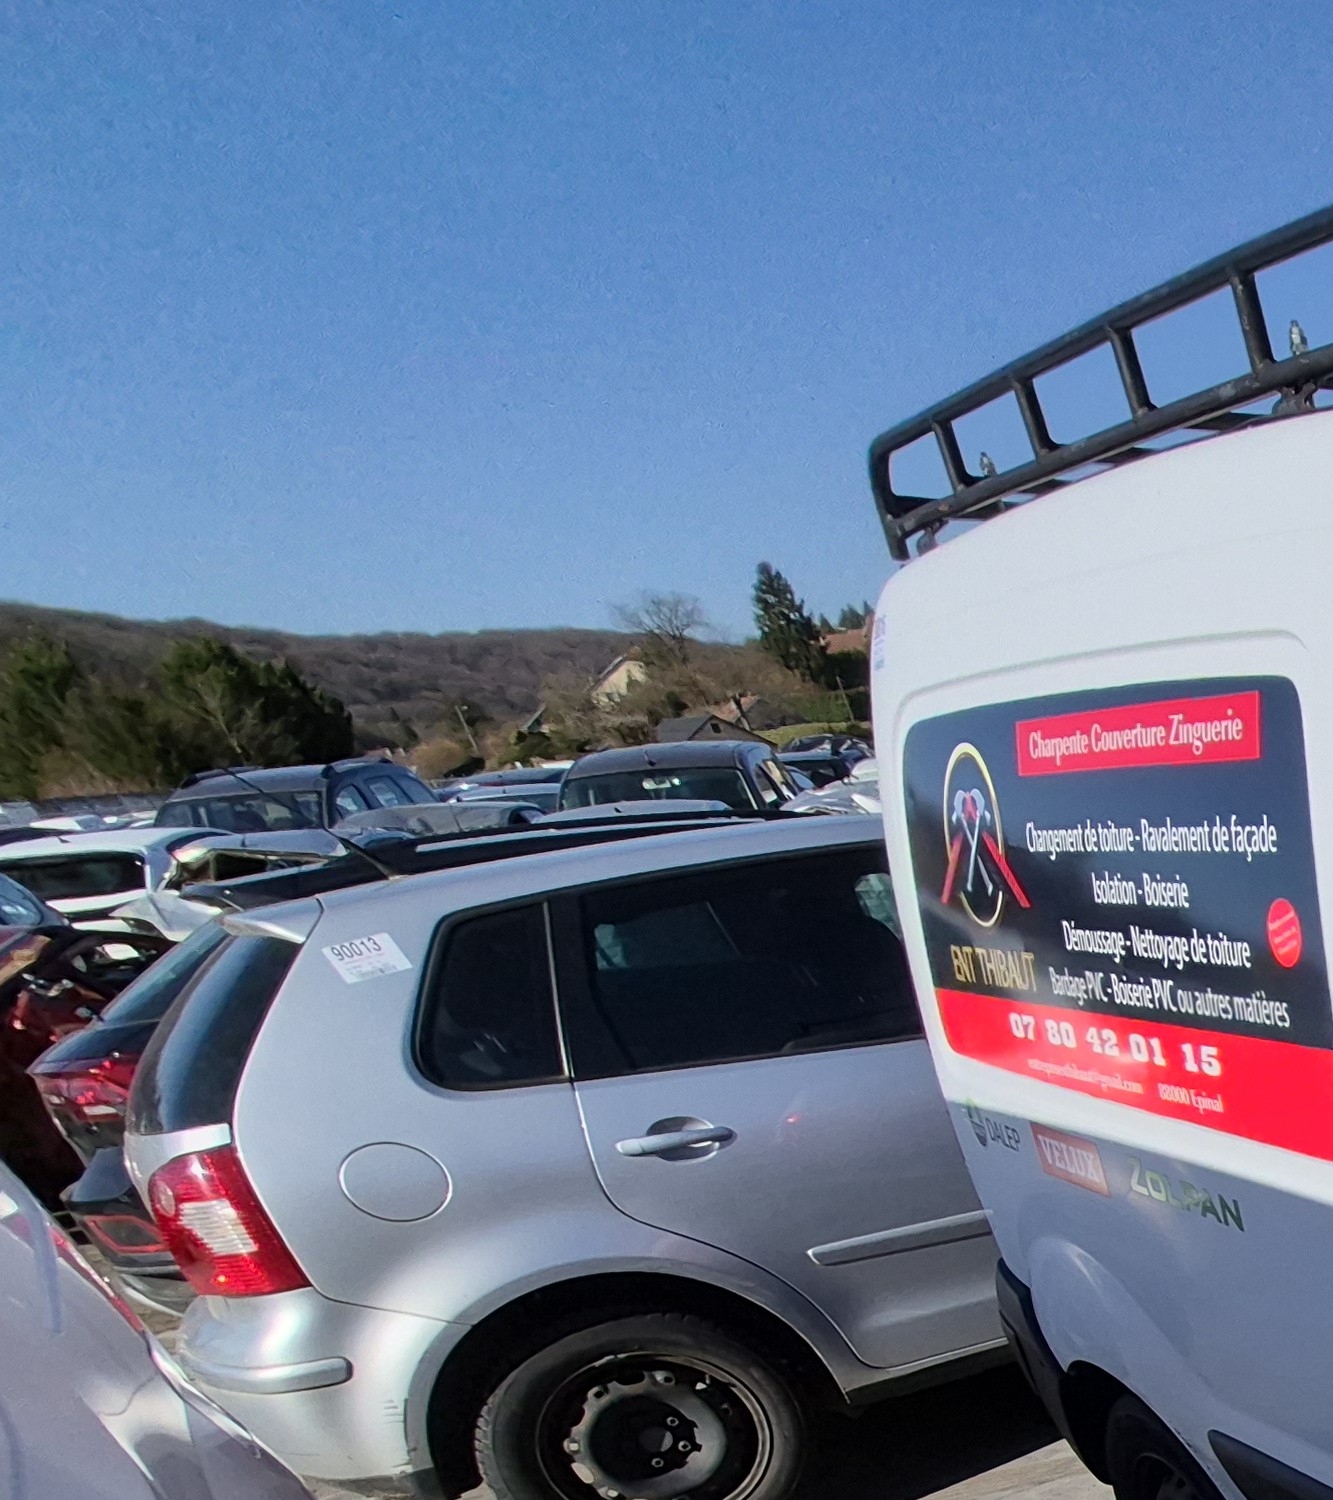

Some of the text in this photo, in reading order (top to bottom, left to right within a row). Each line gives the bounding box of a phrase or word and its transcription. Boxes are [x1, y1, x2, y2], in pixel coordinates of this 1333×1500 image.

[1029, 708, 1243, 766] Charpente Couverture Zinguerie
[1026, 820, 1084, 860] Changement
[1083, 819, 1097, 852] de
[1098, 820, 1135, 852] toiture
[1140, 817, 1210, 852] Ravalement
[1212, 815, 1230, 852] de
[1231, 814, 1278, 862] façade
[1091, 871, 1138, 905] Isolation
[1143, 872, 1190, 907] Boiserie
[331, 936, 382, 961] 90013
[975, 947, 1036, 992] THIBAUT
[1061, 919, 1126, 963] Démoussage
[1129, 925, 1190, 970] Nettoyage
[1190, 928, 1207, 964] de
[1207, 932, 1252, 968] toiture
[1048, 966, 1088, 1006] Bardage
[1084, 970, 1108, 1002] PVC
[1110, 973, 1153, 1009] Boiserie
[1150, 977, 1177, 1012] PVC
[1177, 989, 1194, 1014] ou
[1194, 987, 1233, 1020] autres
[1232, 990, 1291, 1028] matières
[1009, 1012, 1222, 1076] 07 80 42 01 15
[1037, 1134, 1101, 1184] VELUX
